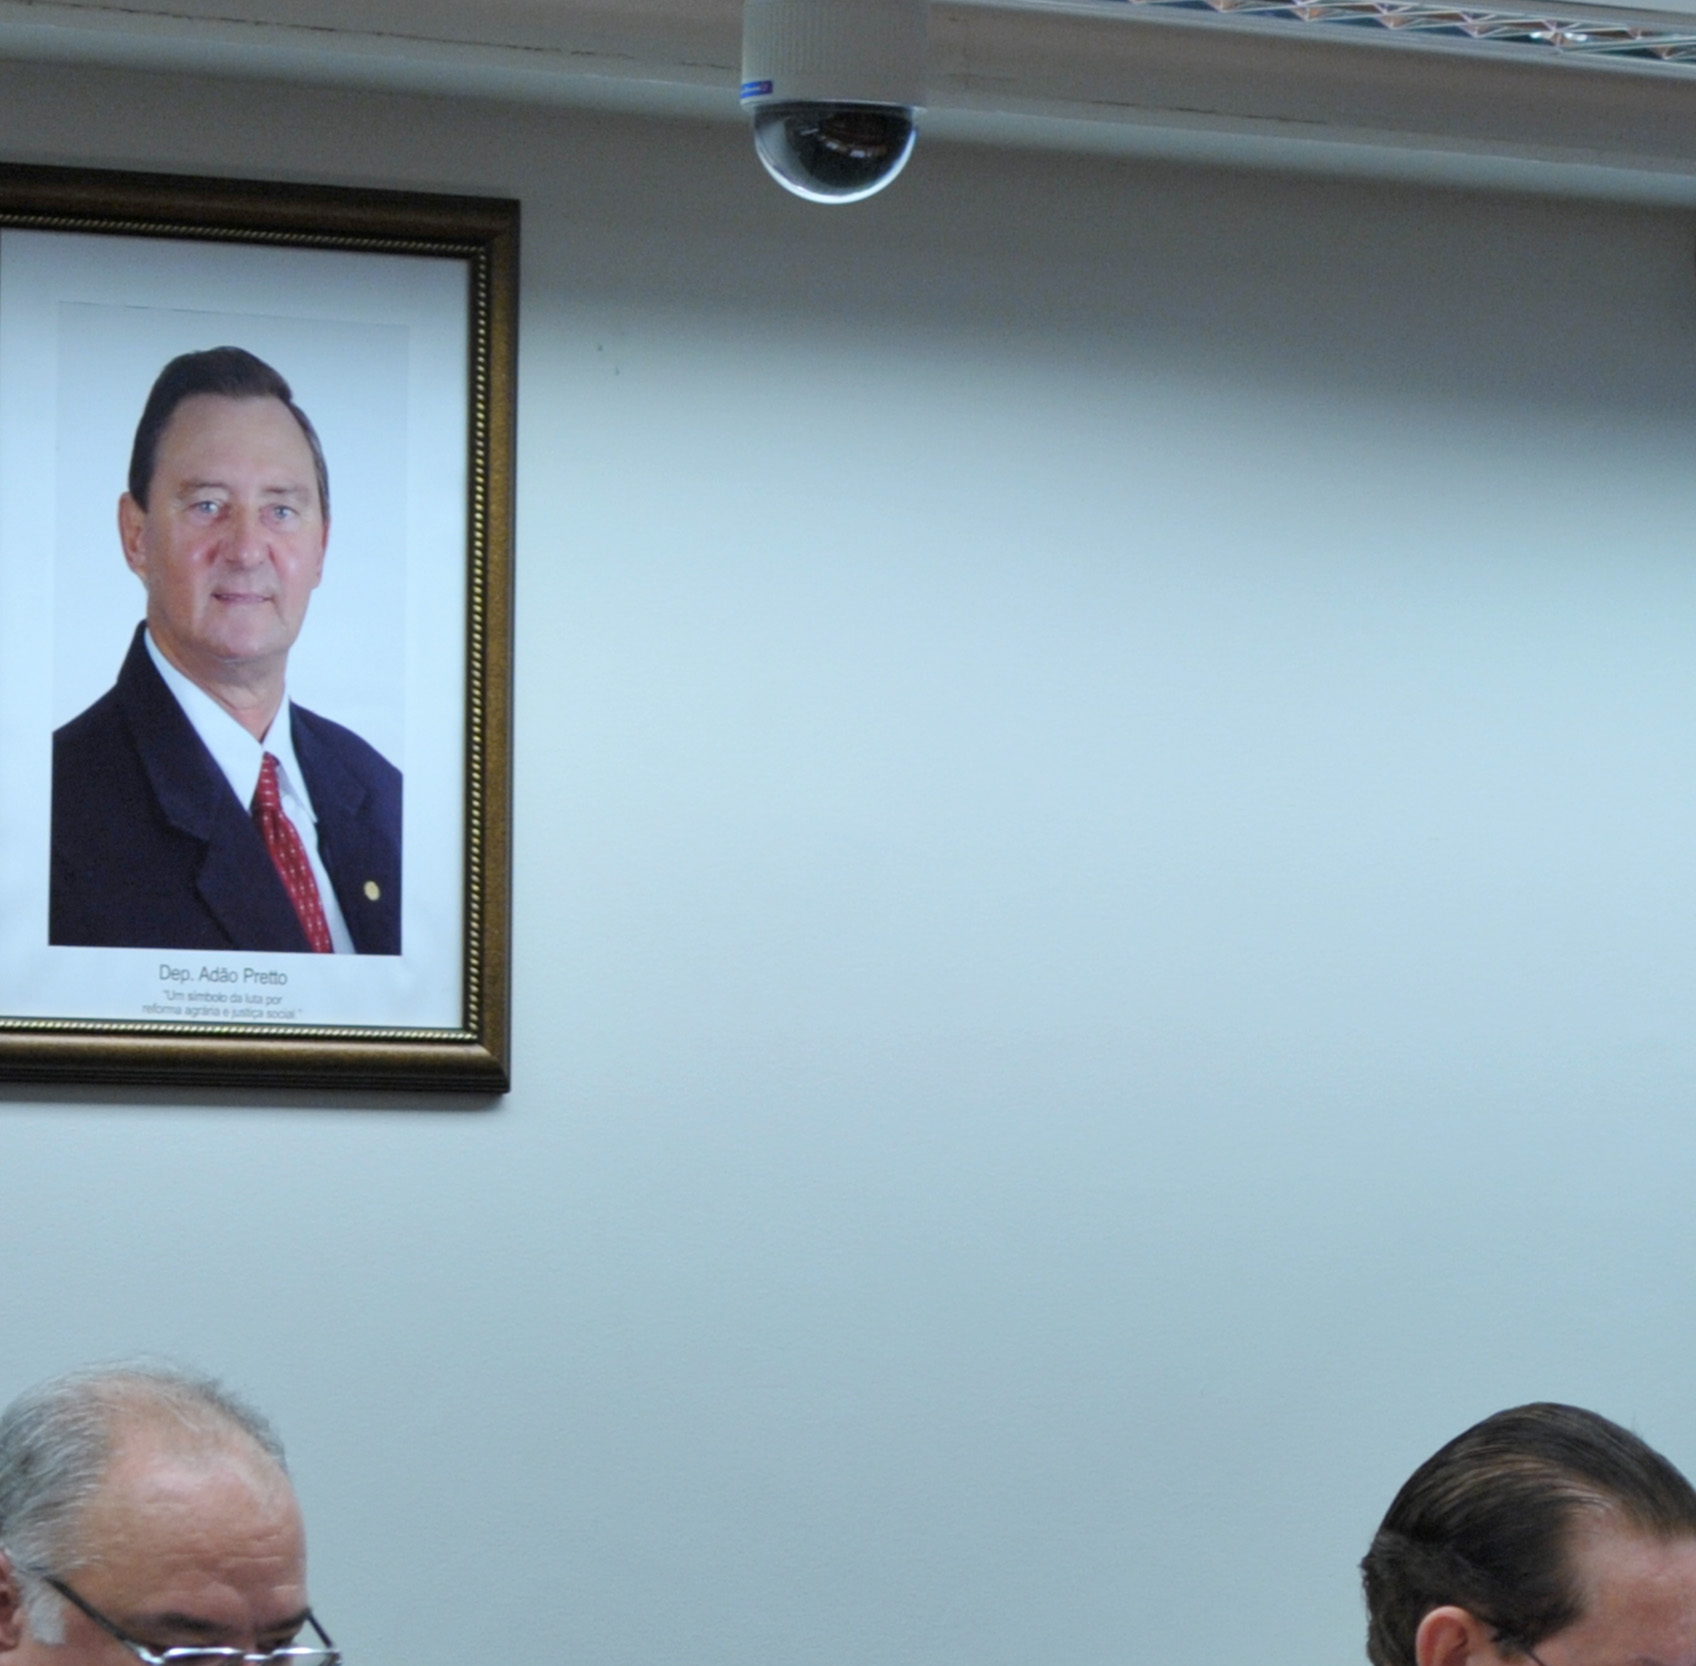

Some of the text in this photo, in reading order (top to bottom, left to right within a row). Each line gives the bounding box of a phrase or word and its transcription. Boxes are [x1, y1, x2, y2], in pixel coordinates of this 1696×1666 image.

[159, 964, 288, 985] Dep. Adão Pretto
